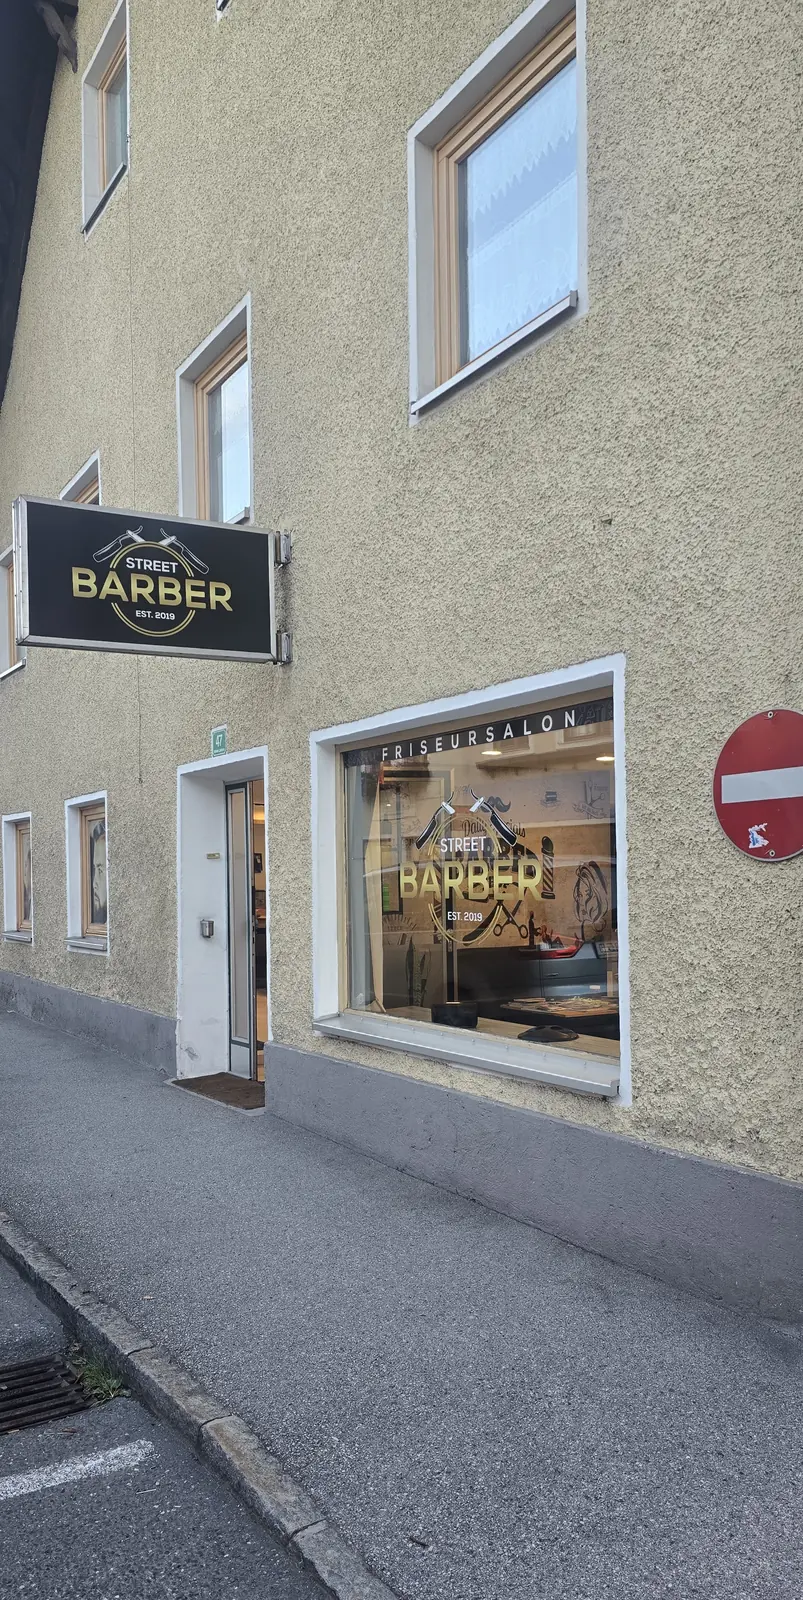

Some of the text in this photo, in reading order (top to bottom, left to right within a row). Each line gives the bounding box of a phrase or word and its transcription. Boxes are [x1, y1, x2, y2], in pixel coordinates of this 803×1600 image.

[126, 557, 179, 574] STREET
[71, 566, 234, 612] BARBER
[135, 610, 175, 621] EST. 2019
[215, 734, 223, 747] 47
[382, 709, 577, 761] FRISEURSALON
[440, 836, 487, 853] STREET
[399, 858, 542, 901] BARBER
[447, 911, 483, 922] EST. 2019
